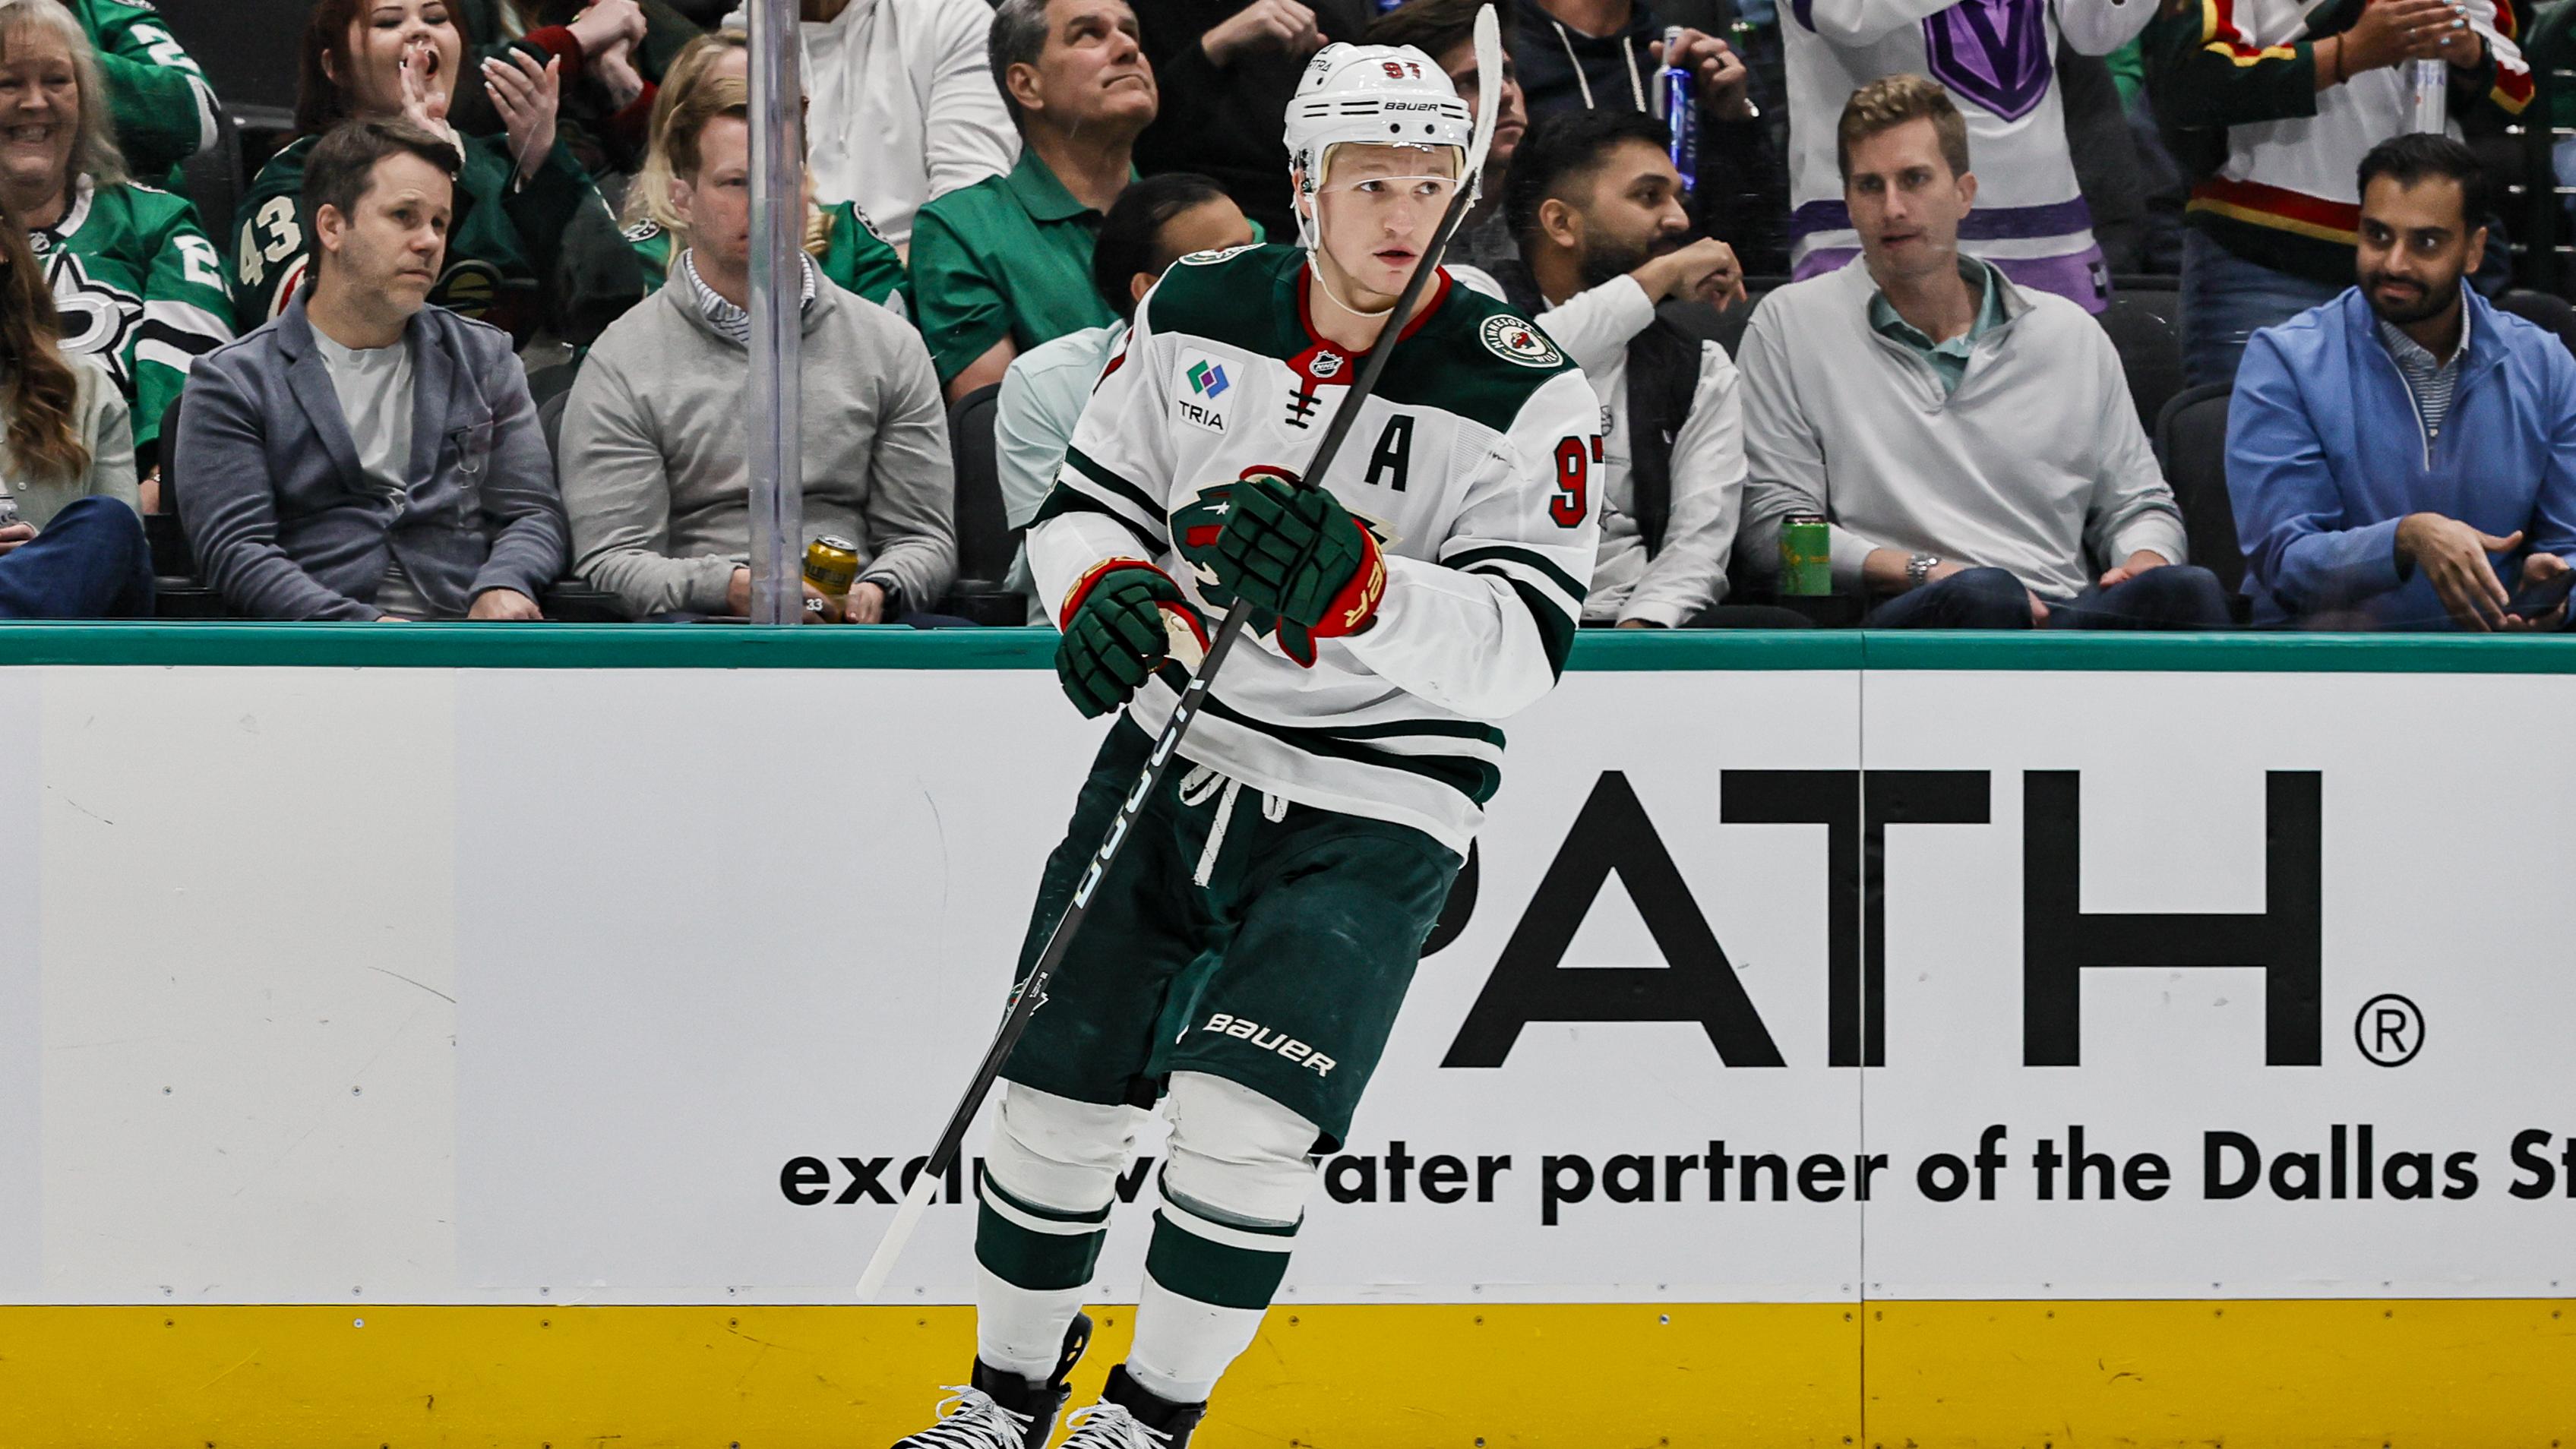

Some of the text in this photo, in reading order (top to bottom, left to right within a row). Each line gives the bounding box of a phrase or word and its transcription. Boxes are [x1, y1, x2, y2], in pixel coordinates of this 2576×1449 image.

[239, 195, 302, 287] 43
[1178, 399, 1224, 431] TRIA
[1364, 413, 1415, 493] A
[806, 598, 823, 611] 33
[1418, 769, 2322, 1067] ATH
[1304, 1141, 1512, 1204] ater
[1541, 1140, 1889, 1226] partner
[1917, 1124, 2007, 1202] of
[2032, 1124, 2171, 1201] the
[2203, 1123, 2480, 1201] Dallas
